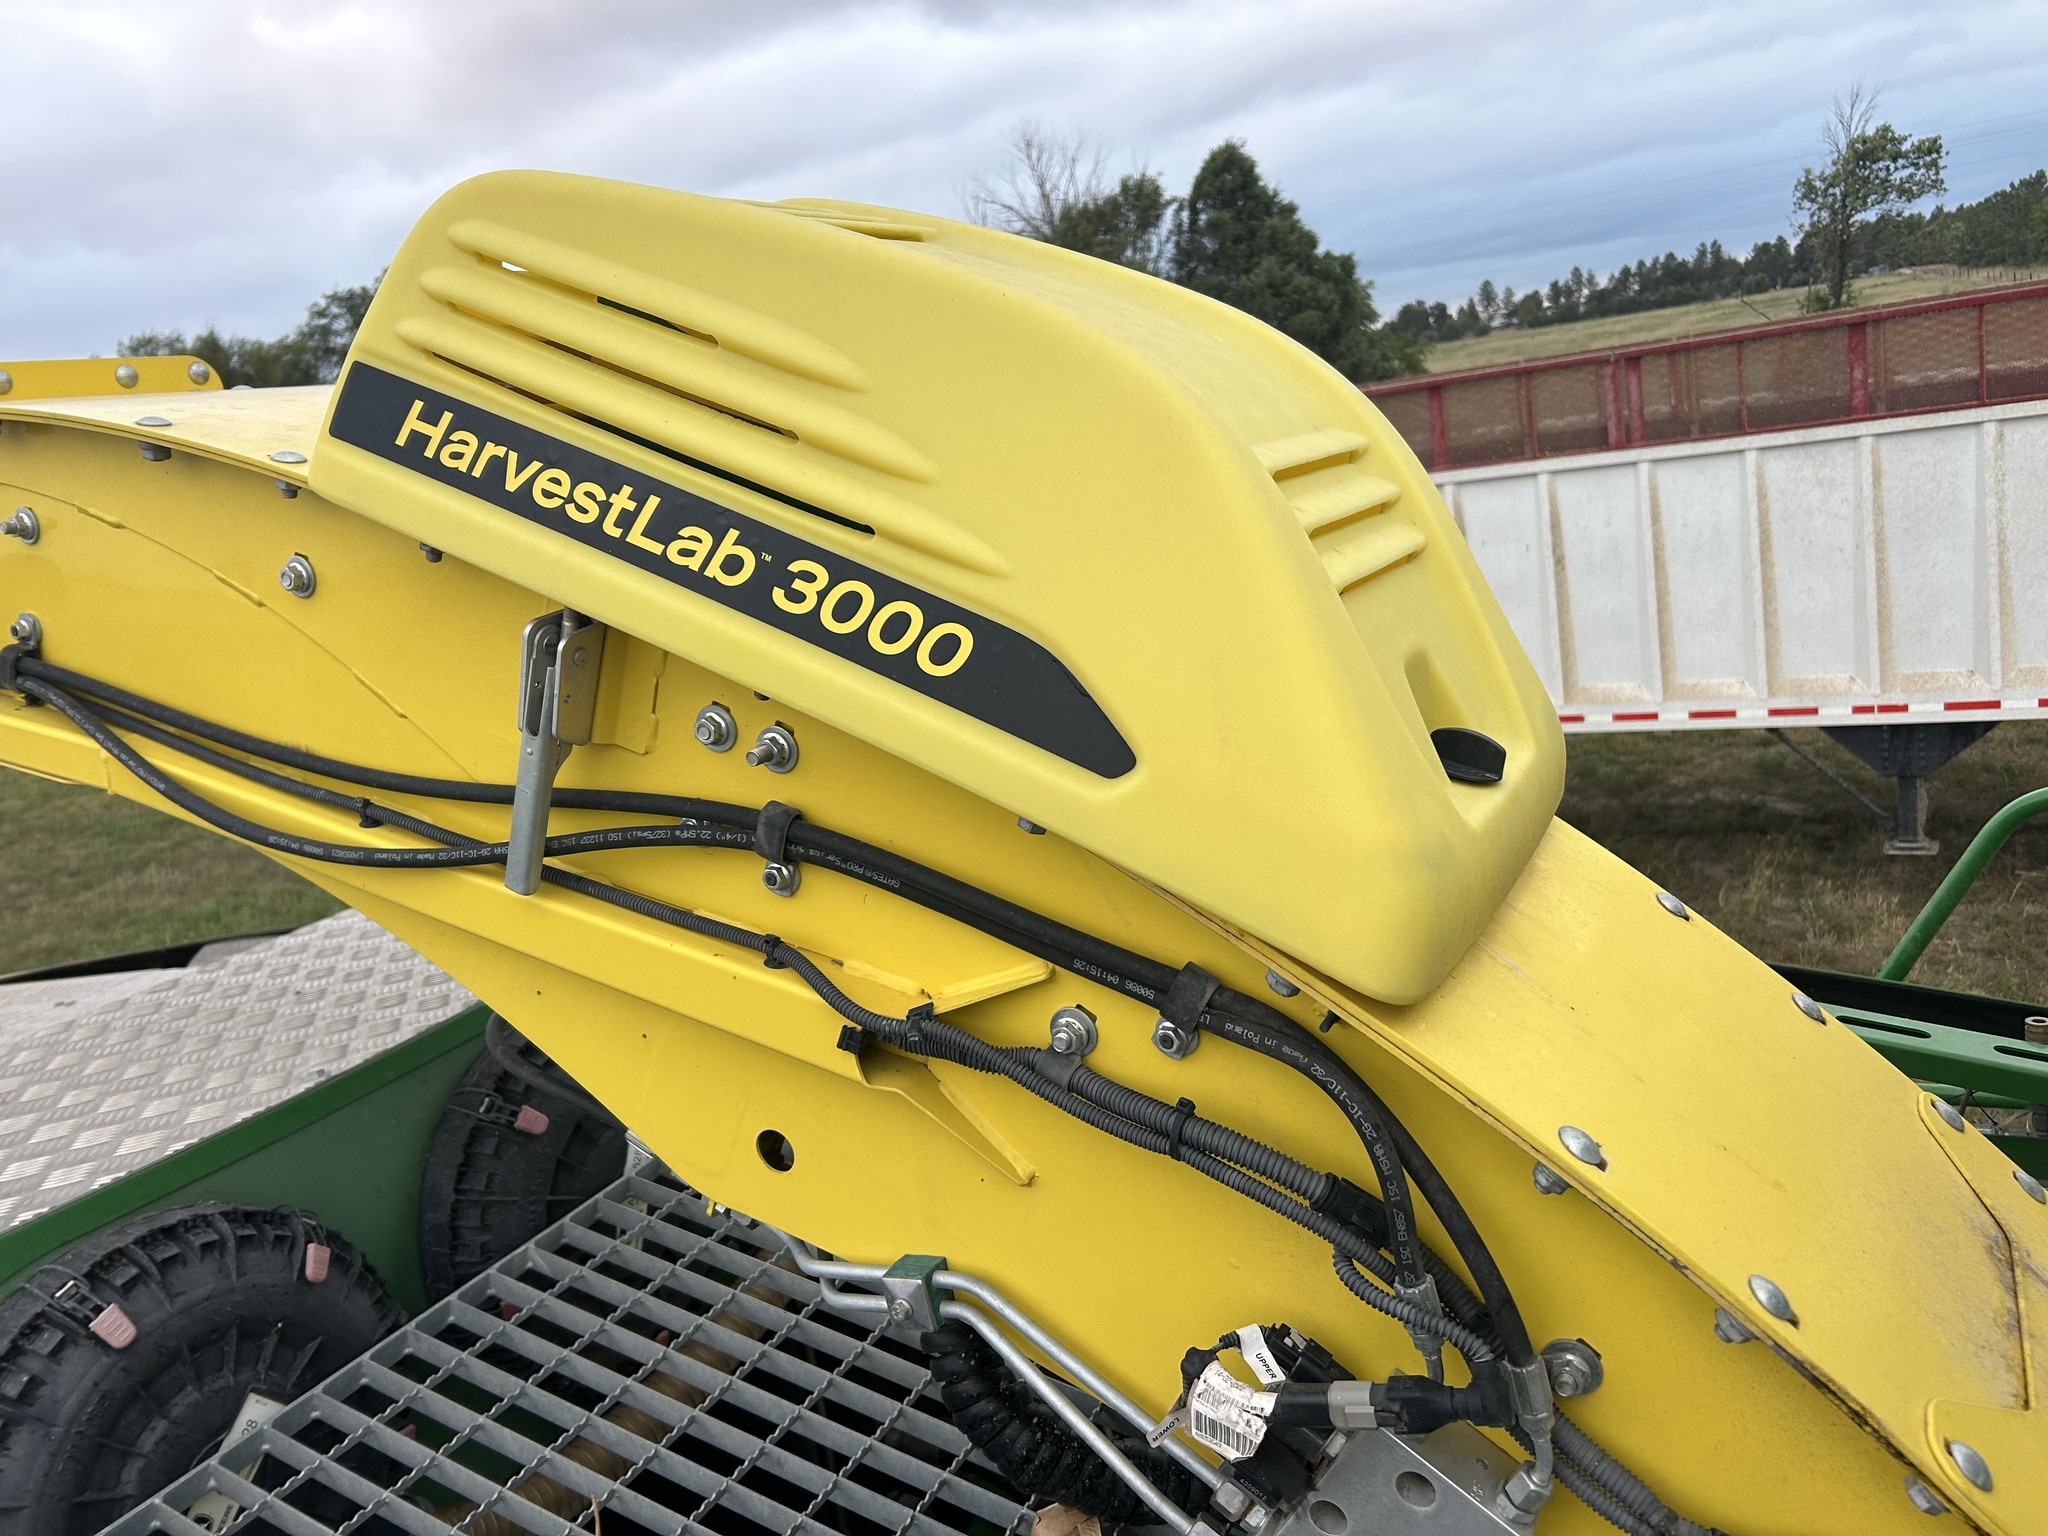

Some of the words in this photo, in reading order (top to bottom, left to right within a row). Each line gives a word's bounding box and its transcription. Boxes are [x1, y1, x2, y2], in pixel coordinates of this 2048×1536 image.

[771, 559, 975, 678] 3000
[580, 834, 603, 845] 11237
[607, 832, 623, 841] ISO
[627, 830, 671, 840] (3275psi)
[675, 830, 712, 839] 22.5MPa
[716, 831, 747, 843] (1/4")
[374, 852, 401, 862] Poland
[416, 852, 435, 861] Made
[494, 845, 510, 855] SHA
[808, 848, 842, 866] Series
[1072, 958, 1120, 985] 04:15:26
[1124, 979, 1155, 1000] 50086
[1224, 1022, 1261, 1044] Poland
[1264, 1036, 1278, 1049] in
[1310, 1063, 1378, 1140] 2G-IC-11C/32
[1373, 1143, 1392, 1175] MSHA
[1393, 1208, 1408, 1241] EN857
[1255, 1352, 1277, 1380] UPPER
[1151, 1417, 1181, 1443] LOWER
[1239, 1477, 1268, 1501] 4309012
